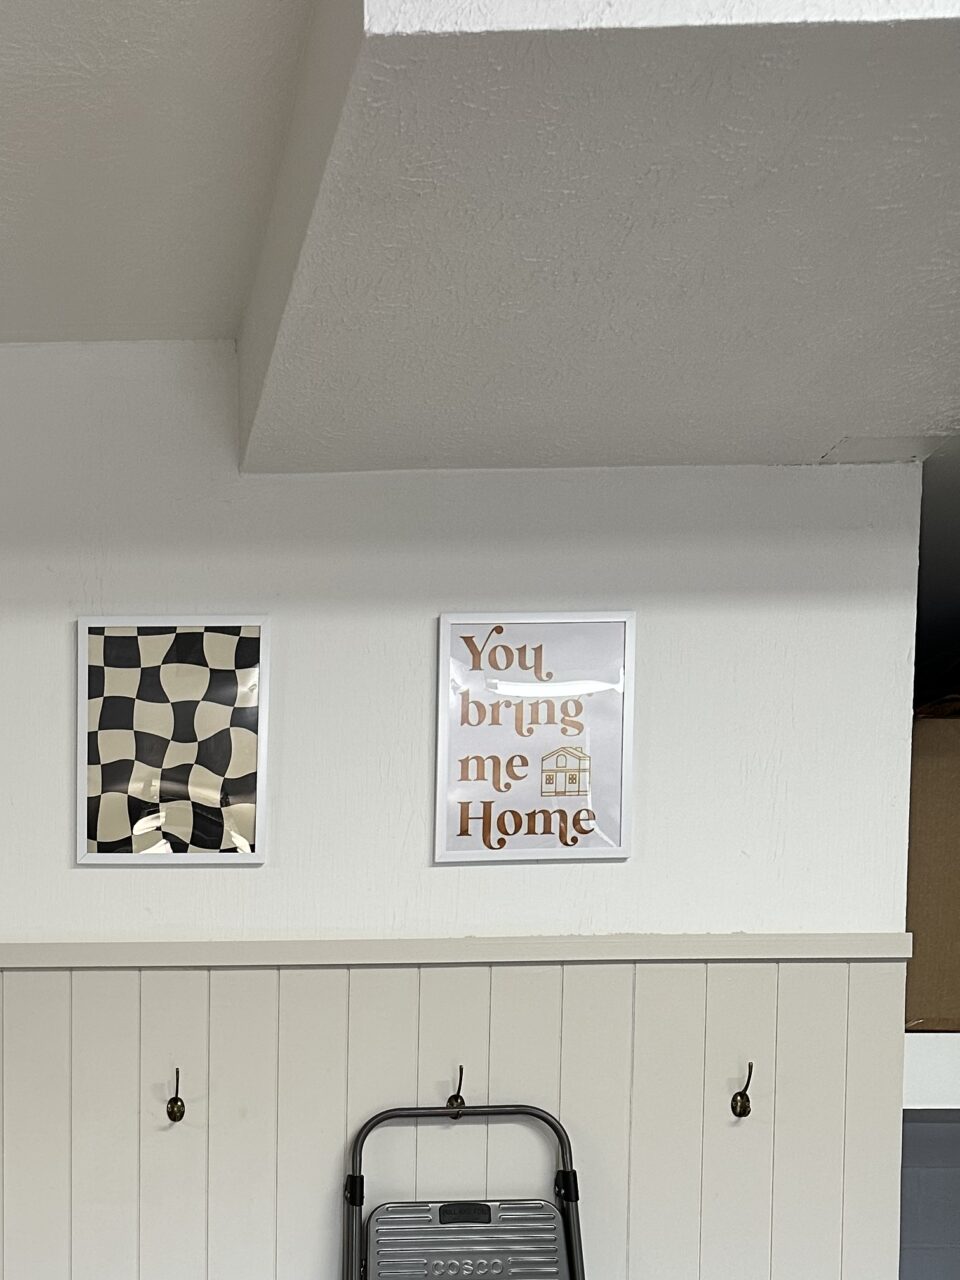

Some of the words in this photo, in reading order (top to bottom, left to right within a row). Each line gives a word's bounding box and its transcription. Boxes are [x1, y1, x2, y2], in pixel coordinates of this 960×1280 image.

[460, 625, 553, 682] You
[460, 688, 592, 738] bring
[458, 754, 529, 793] me
[456, 801, 596, 850] Home
[431, 1259, 503, 1276] COSCO
